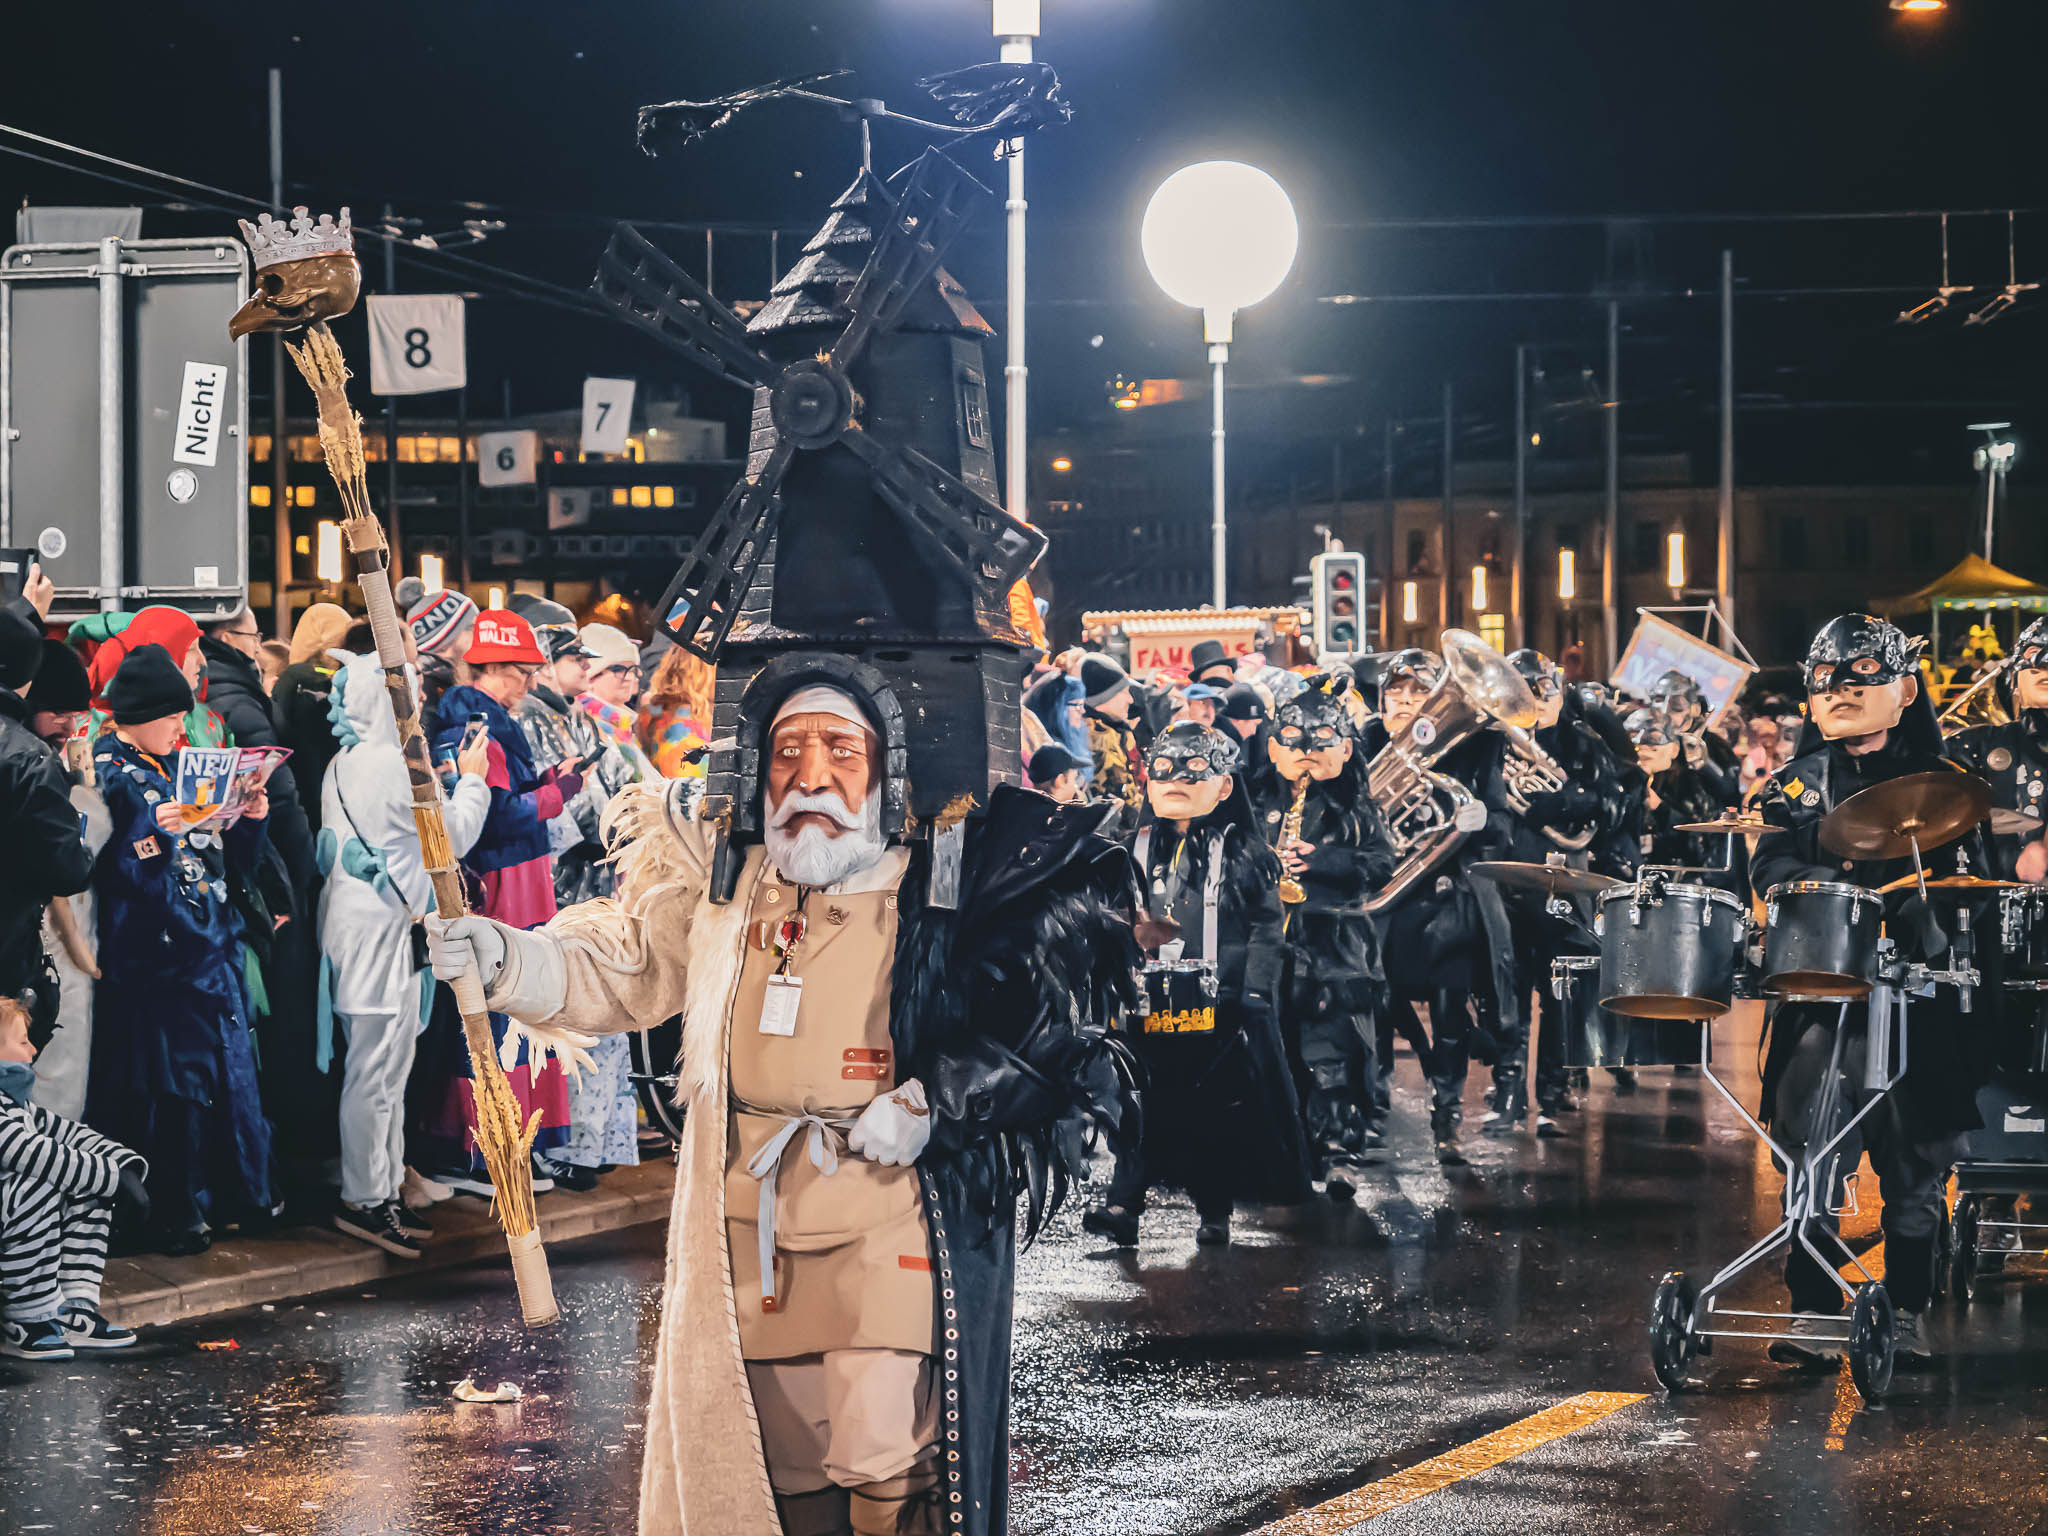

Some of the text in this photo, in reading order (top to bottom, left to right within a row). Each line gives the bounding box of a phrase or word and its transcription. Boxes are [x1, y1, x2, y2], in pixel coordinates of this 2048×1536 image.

[405, 328, 431, 368] 8
[185, 372, 216, 455] Nicht.
[596, 402, 612, 432] 7
[497, 447, 514, 471] 6
[184, 753, 233, 776] NEU
